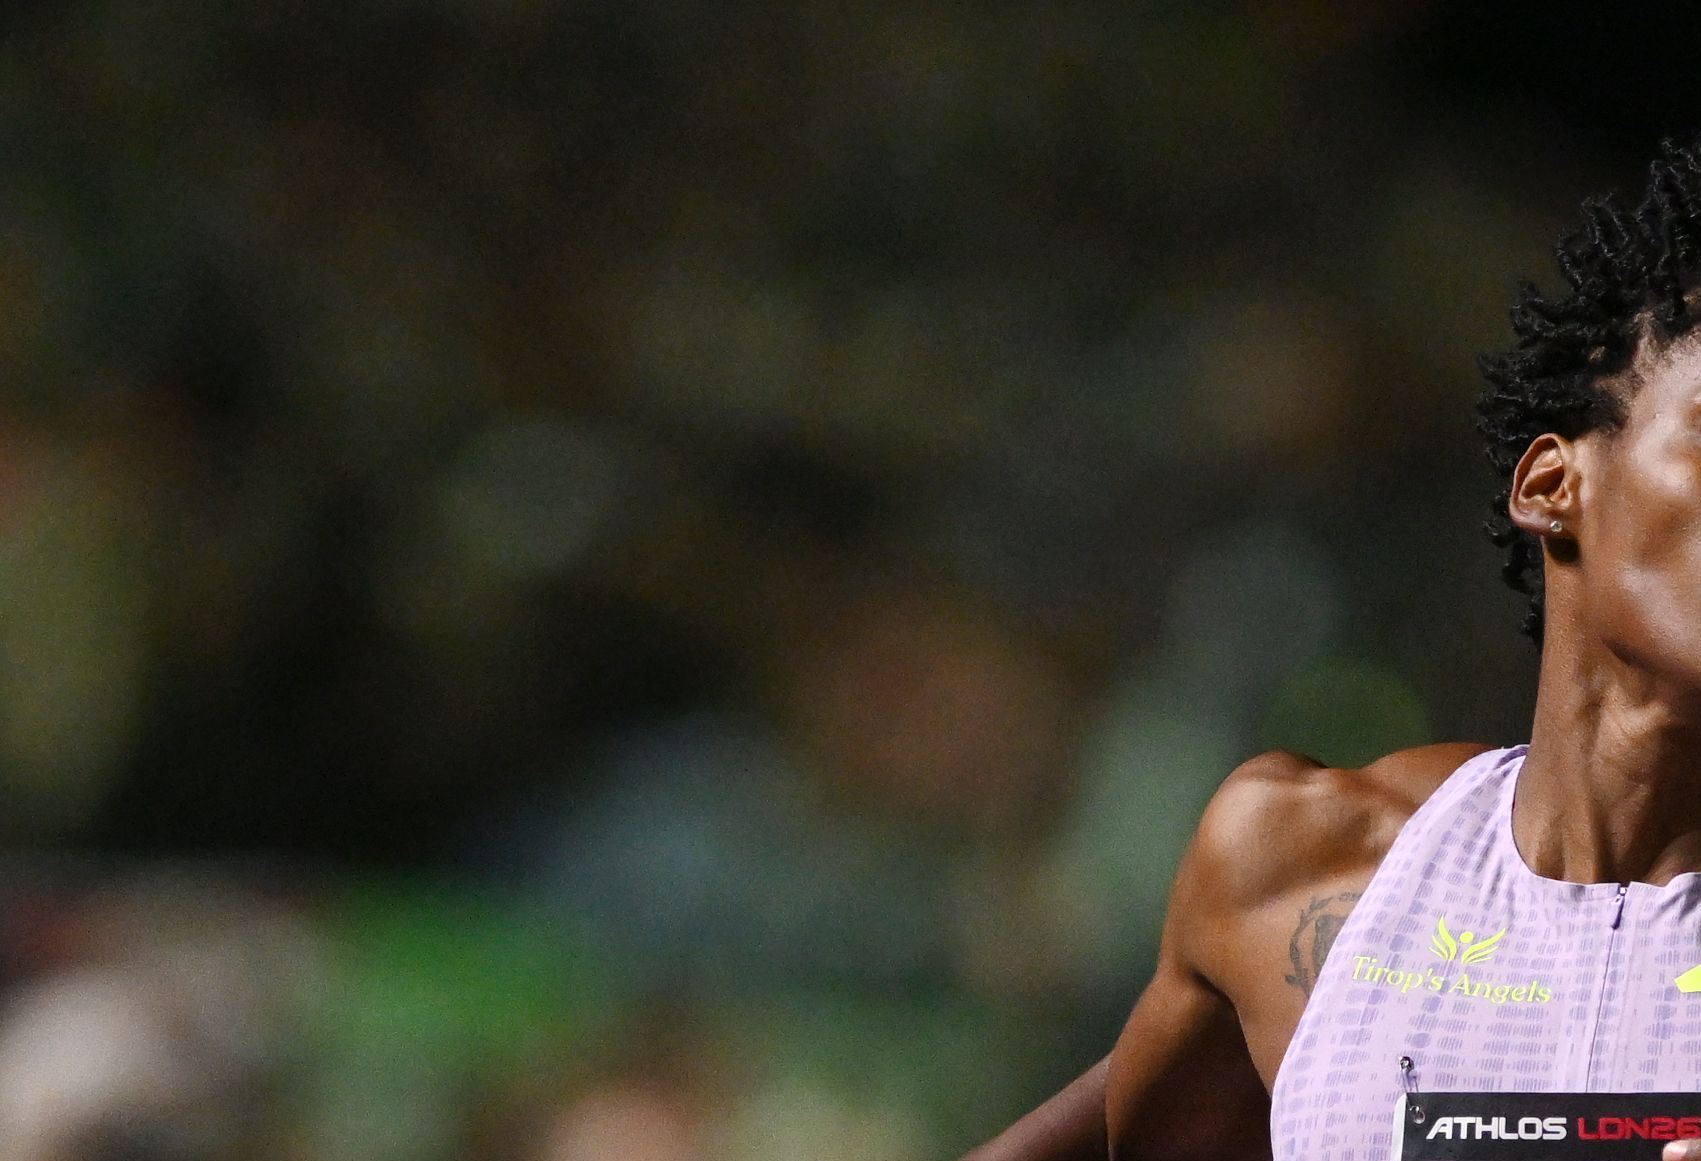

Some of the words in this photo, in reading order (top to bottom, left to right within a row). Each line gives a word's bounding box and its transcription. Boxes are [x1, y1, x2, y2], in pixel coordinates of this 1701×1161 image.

[1351, 955, 1446, 994] Tirop's
[1448, 972, 1552, 1005] Angels
[1426, 1116, 1567, 1141] ATHLOS
